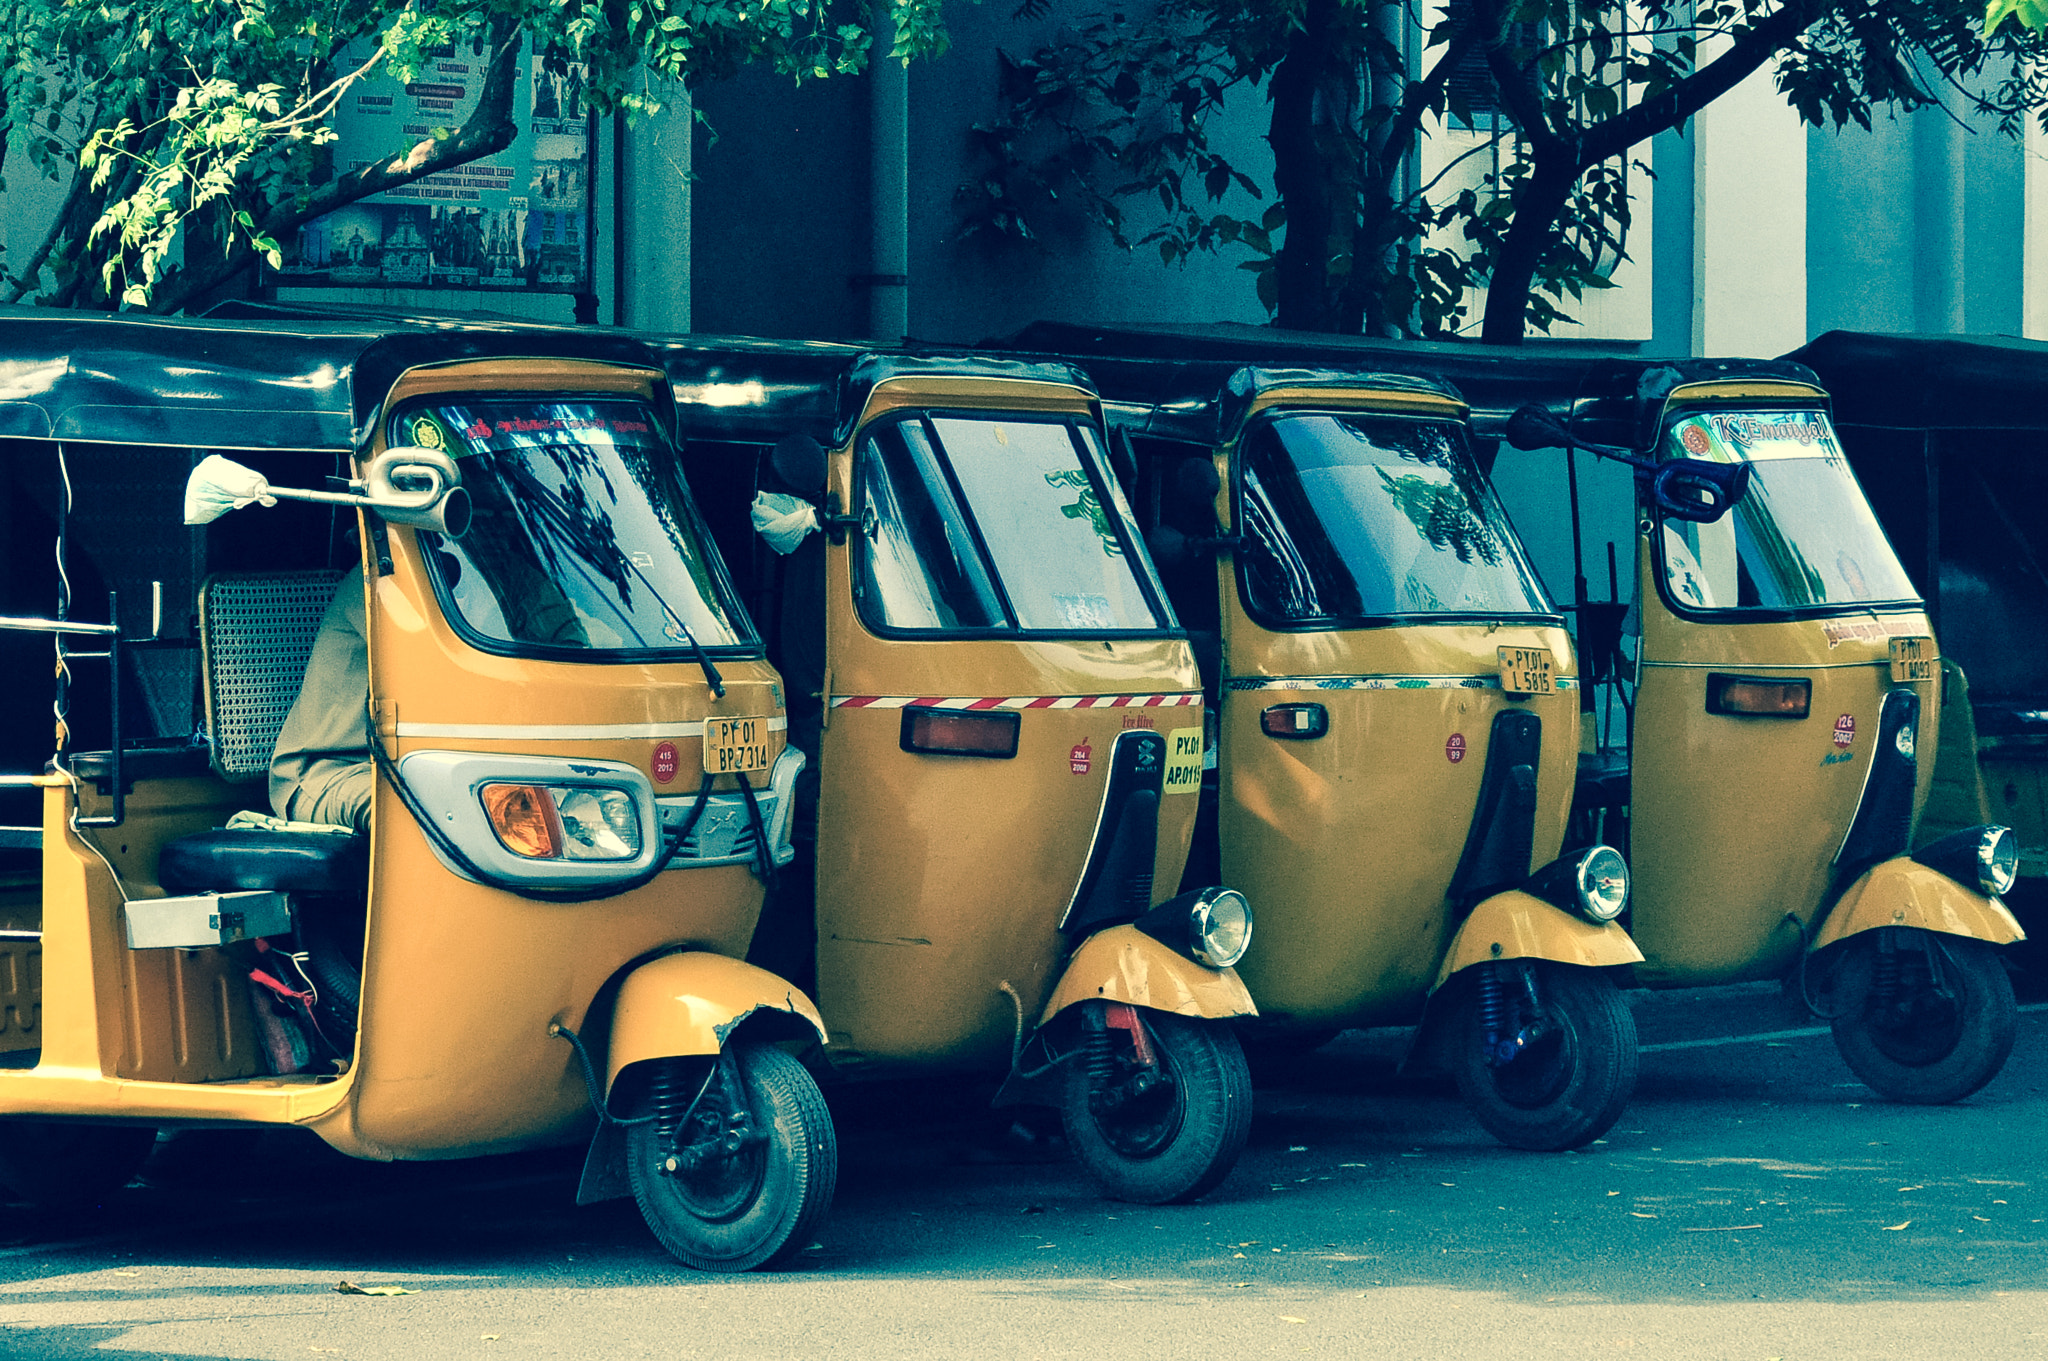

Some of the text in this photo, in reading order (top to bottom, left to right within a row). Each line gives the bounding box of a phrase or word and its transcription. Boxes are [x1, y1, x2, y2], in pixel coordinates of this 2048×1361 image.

[1512, 671, 1550, 692] L 5815
[1838, 715, 1853, 728] 126
[721, 720, 755, 745] PY 01
[1451, 737, 1460, 746] 20
[660, 751, 672, 760] 415
[719, 745, 767, 771] BP 7314
[657, 763, 674, 772] 2012
